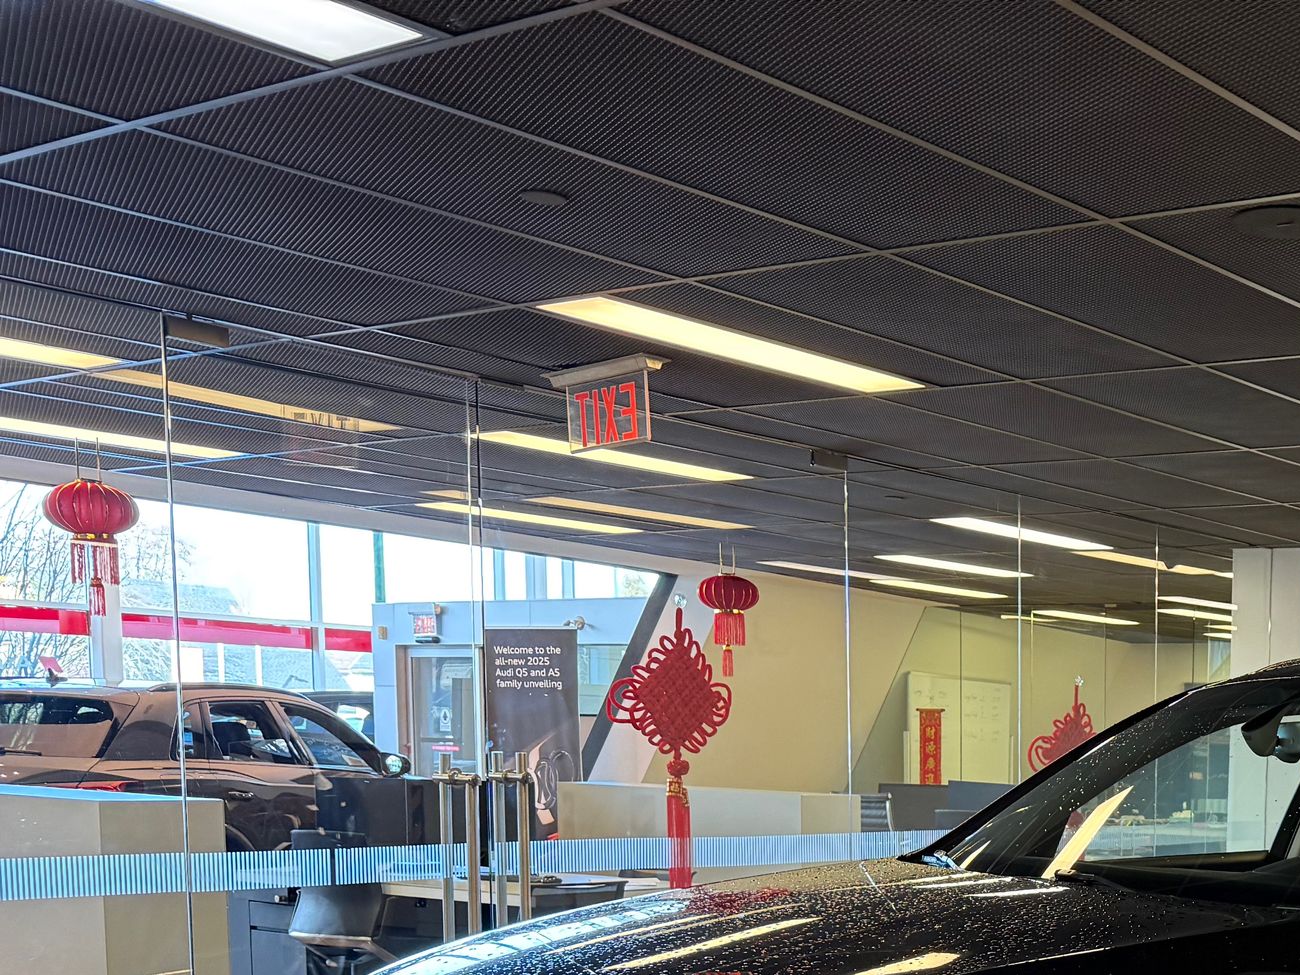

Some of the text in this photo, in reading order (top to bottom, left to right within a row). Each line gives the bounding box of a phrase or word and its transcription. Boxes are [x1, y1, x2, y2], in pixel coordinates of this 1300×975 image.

[493, 645, 562, 655] Welcome to the
[494, 656, 550, 666] all-new 2025
[495, 667, 514, 677] Audi
[515, 668, 528, 677] Q5
[529, 668, 546, 677] and
[496, 679, 563, 690] family unveiling
